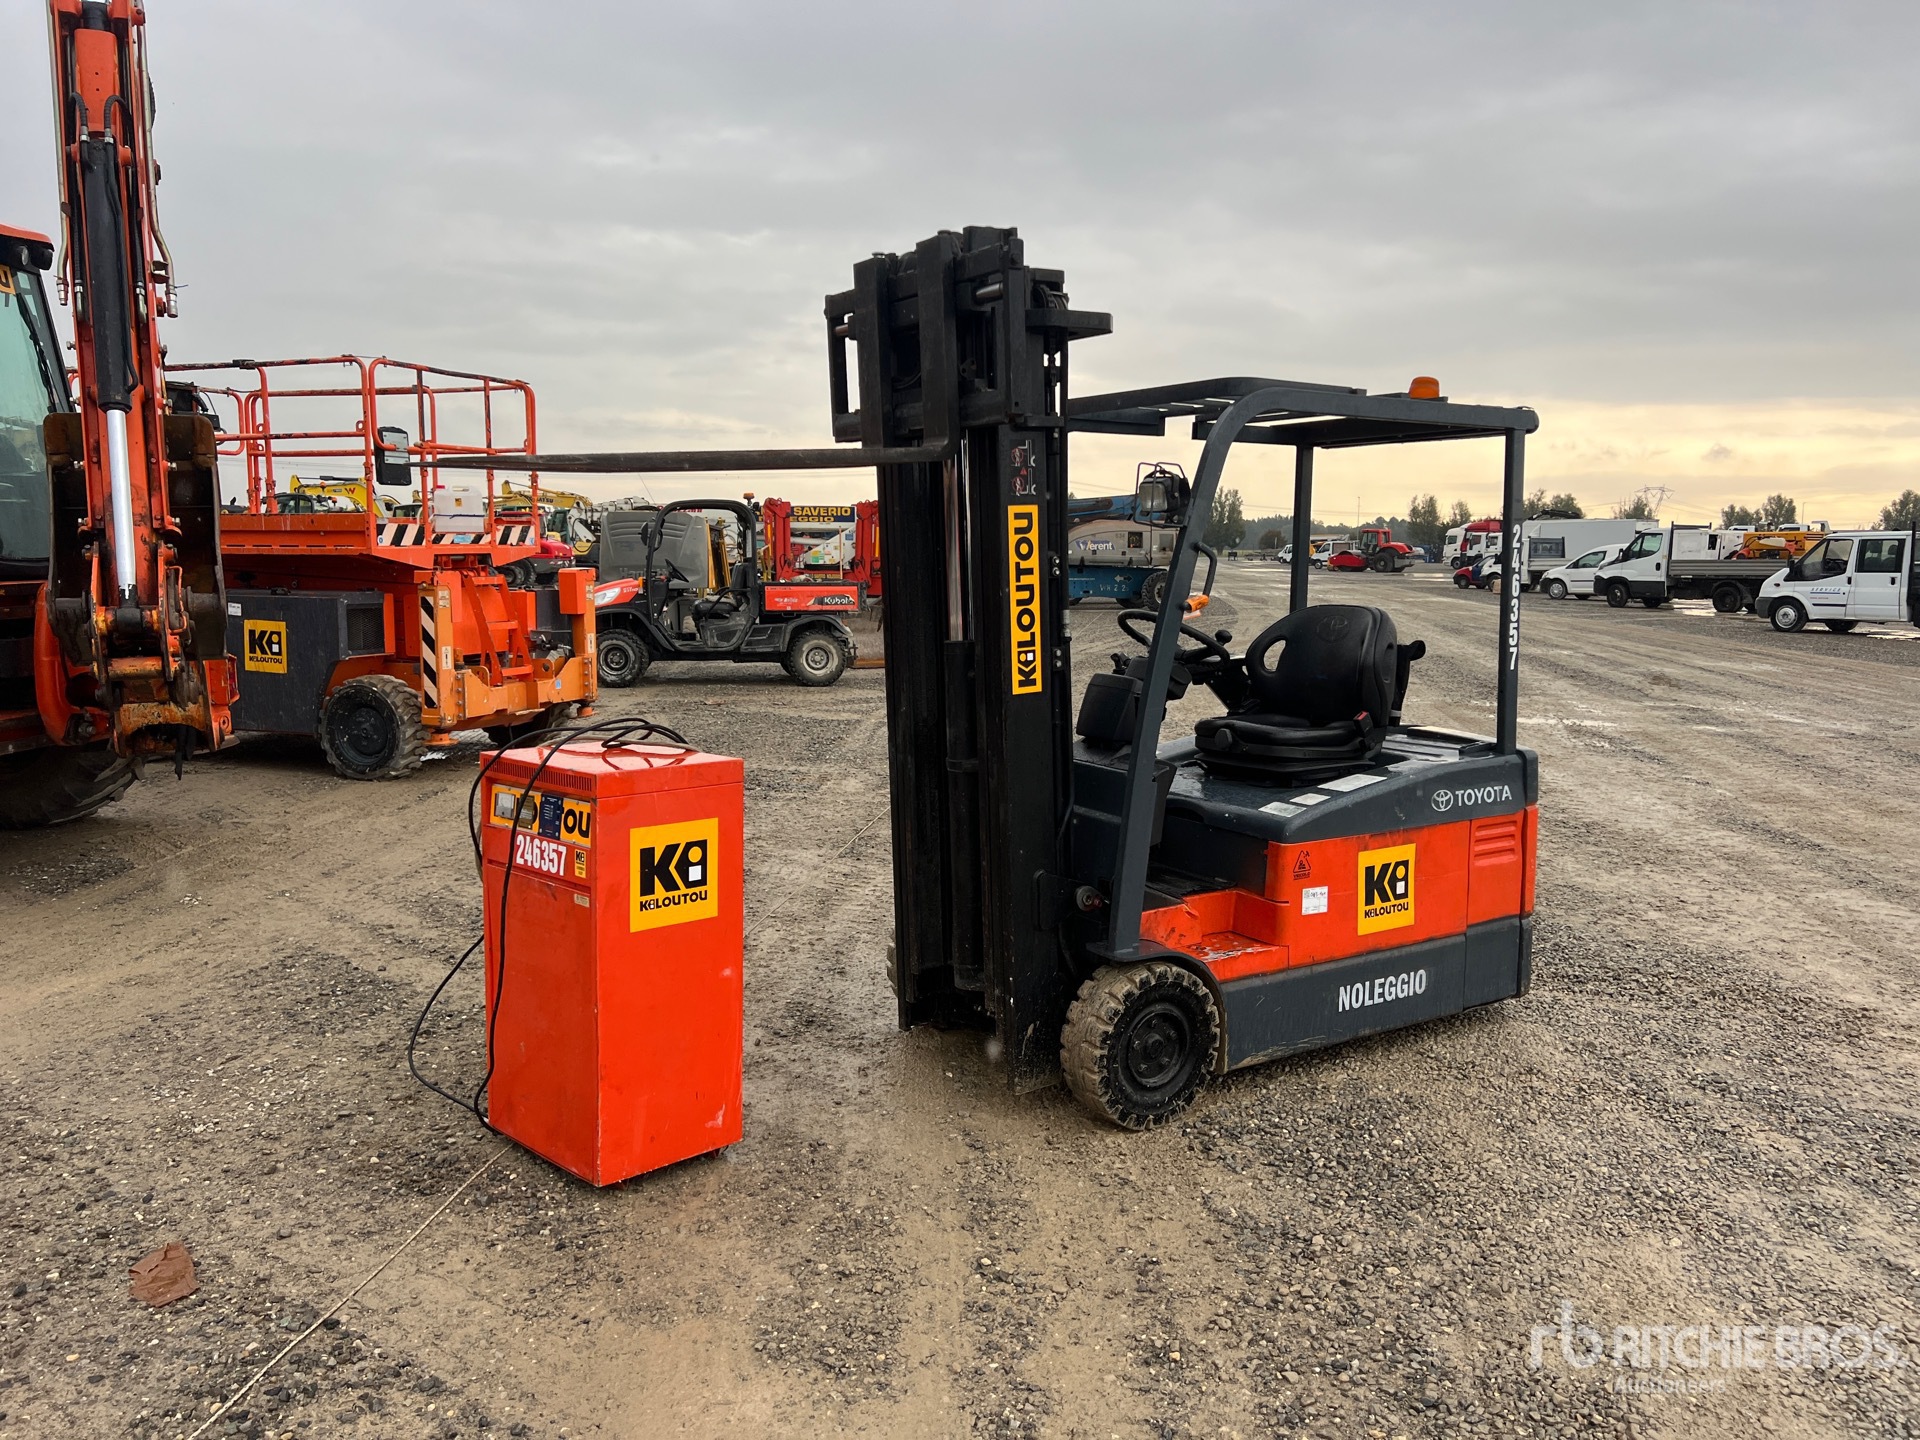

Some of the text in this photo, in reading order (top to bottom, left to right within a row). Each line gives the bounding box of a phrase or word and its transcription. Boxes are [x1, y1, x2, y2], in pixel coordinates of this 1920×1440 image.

[793, 506, 851, 516] SAVERIO
[1508, 523, 1521, 671] 246357
[1455, 785, 1512, 807] TOYOTA
[515, 834, 567, 876] 246357
[1338, 969, 1427, 1013] NOLEGGIO
